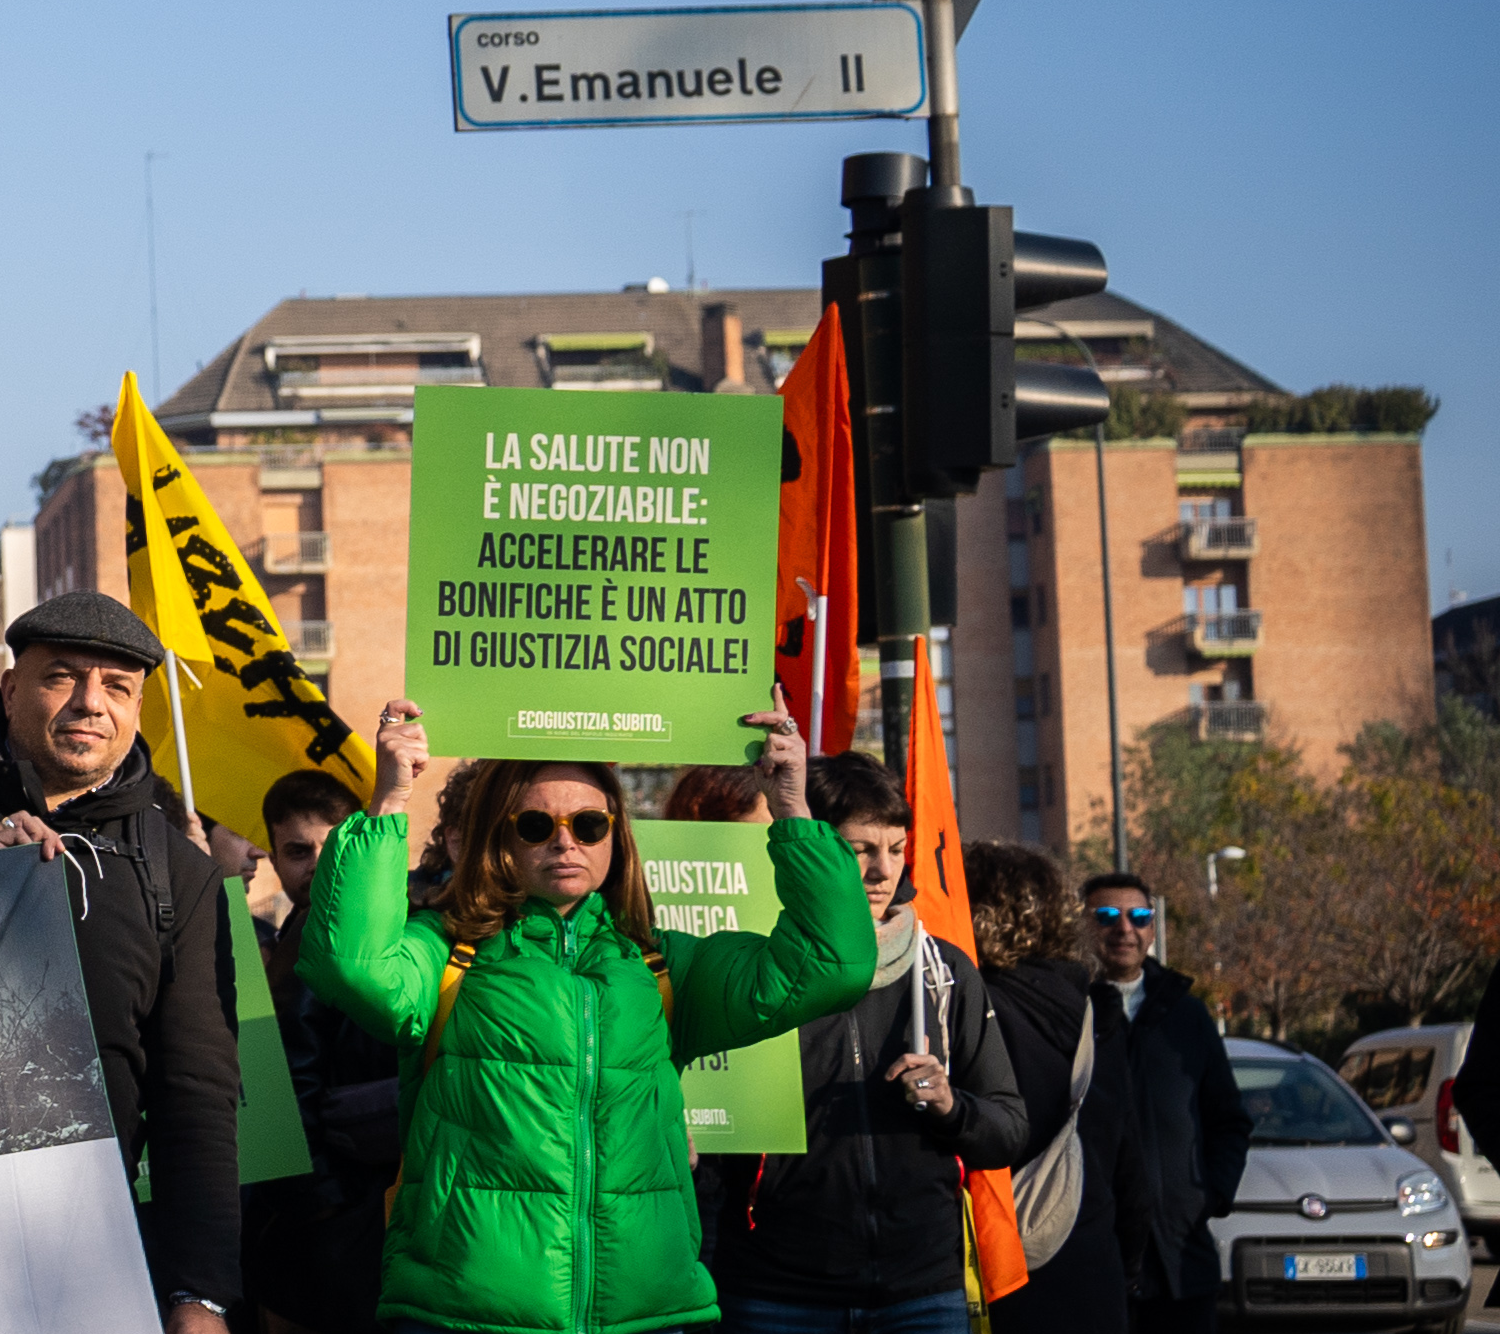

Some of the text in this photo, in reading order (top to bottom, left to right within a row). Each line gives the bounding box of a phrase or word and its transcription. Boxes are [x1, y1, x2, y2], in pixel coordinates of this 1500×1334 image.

[476, 28, 540, 48] corso
[480, 53, 866, 103] V.Emanuele II
[484, 432, 710, 475] LA SALUTE NON
[484, 475, 708, 525] È NEGOZIABILE:
[477, 531, 709, 574] ACCELERARE LE
[438, 576, 747, 625] BONIFICHE È UN ATTO
[433, 628, 749, 675] DI GIUSTIZIA SOCIALE!
[518, 710, 665, 732] ECOGIUSTIZIA SUBITO.
[644, 860, 748, 895] GIUSTIZIA
